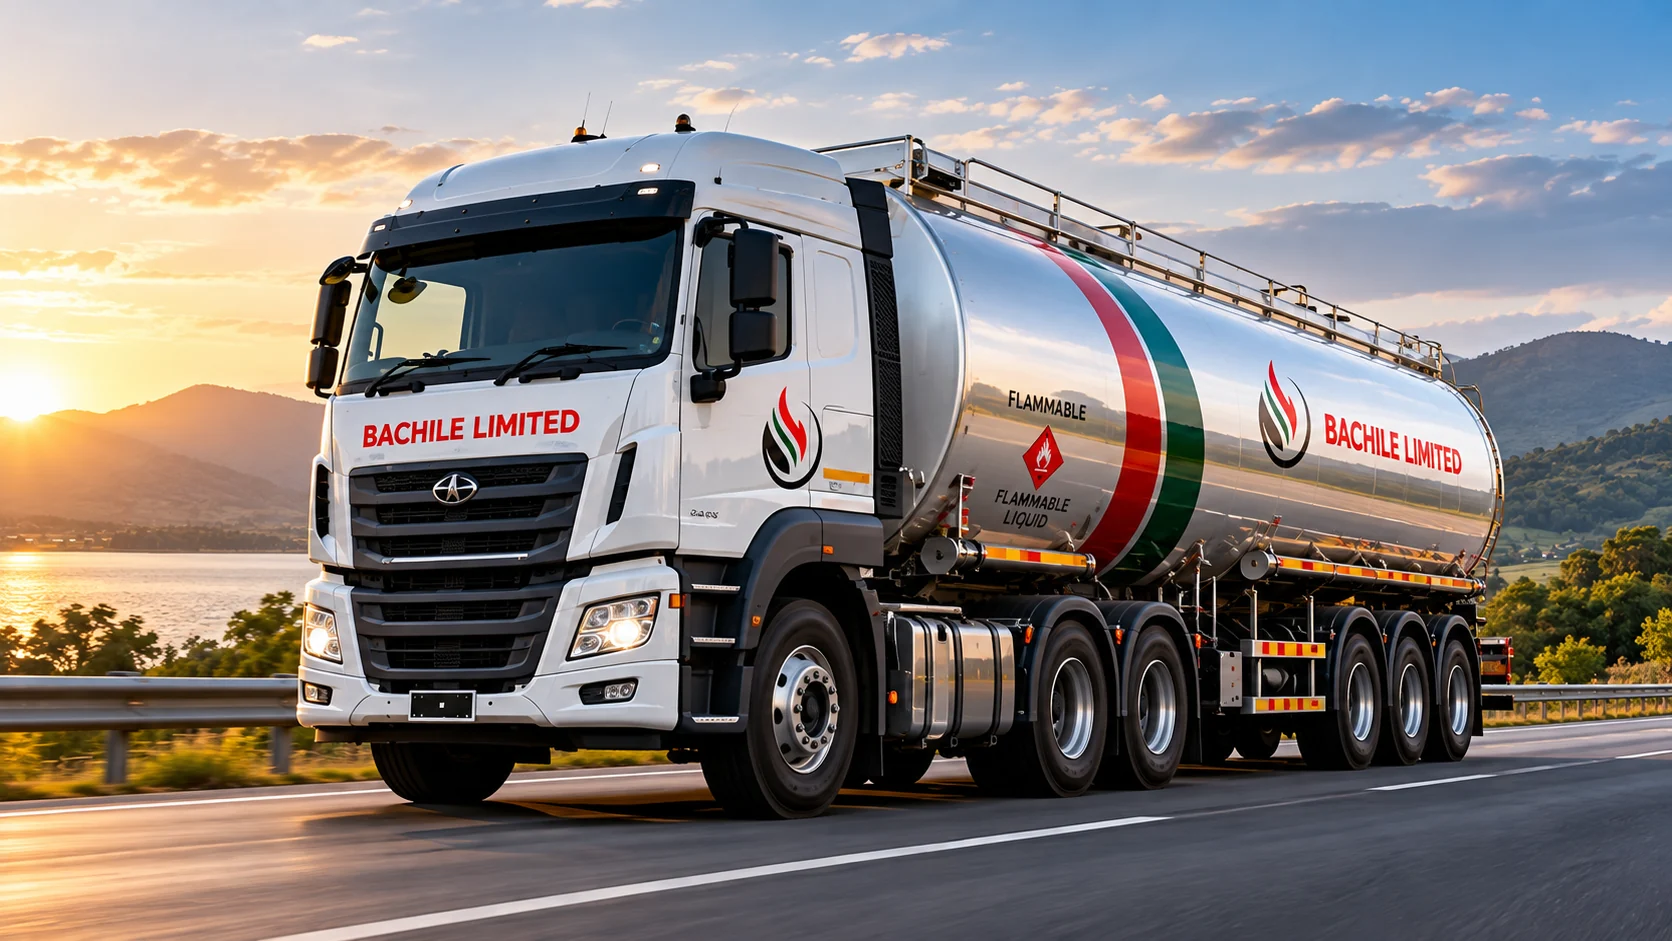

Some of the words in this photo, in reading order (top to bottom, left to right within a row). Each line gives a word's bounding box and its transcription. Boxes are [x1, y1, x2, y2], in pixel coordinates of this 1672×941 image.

[1008, 390, 1087, 421] FLAMMABLE
[362, 416, 465, 448] BACHILE
[473, 409, 581, 439] LIMITED
[1324, 413, 1400, 461] BACHILE
[1404, 435, 1462, 475] LIMITED
[995, 489, 1071, 513] FLAMMABLE
[1003, 509, 1048, 529] LIQUID
